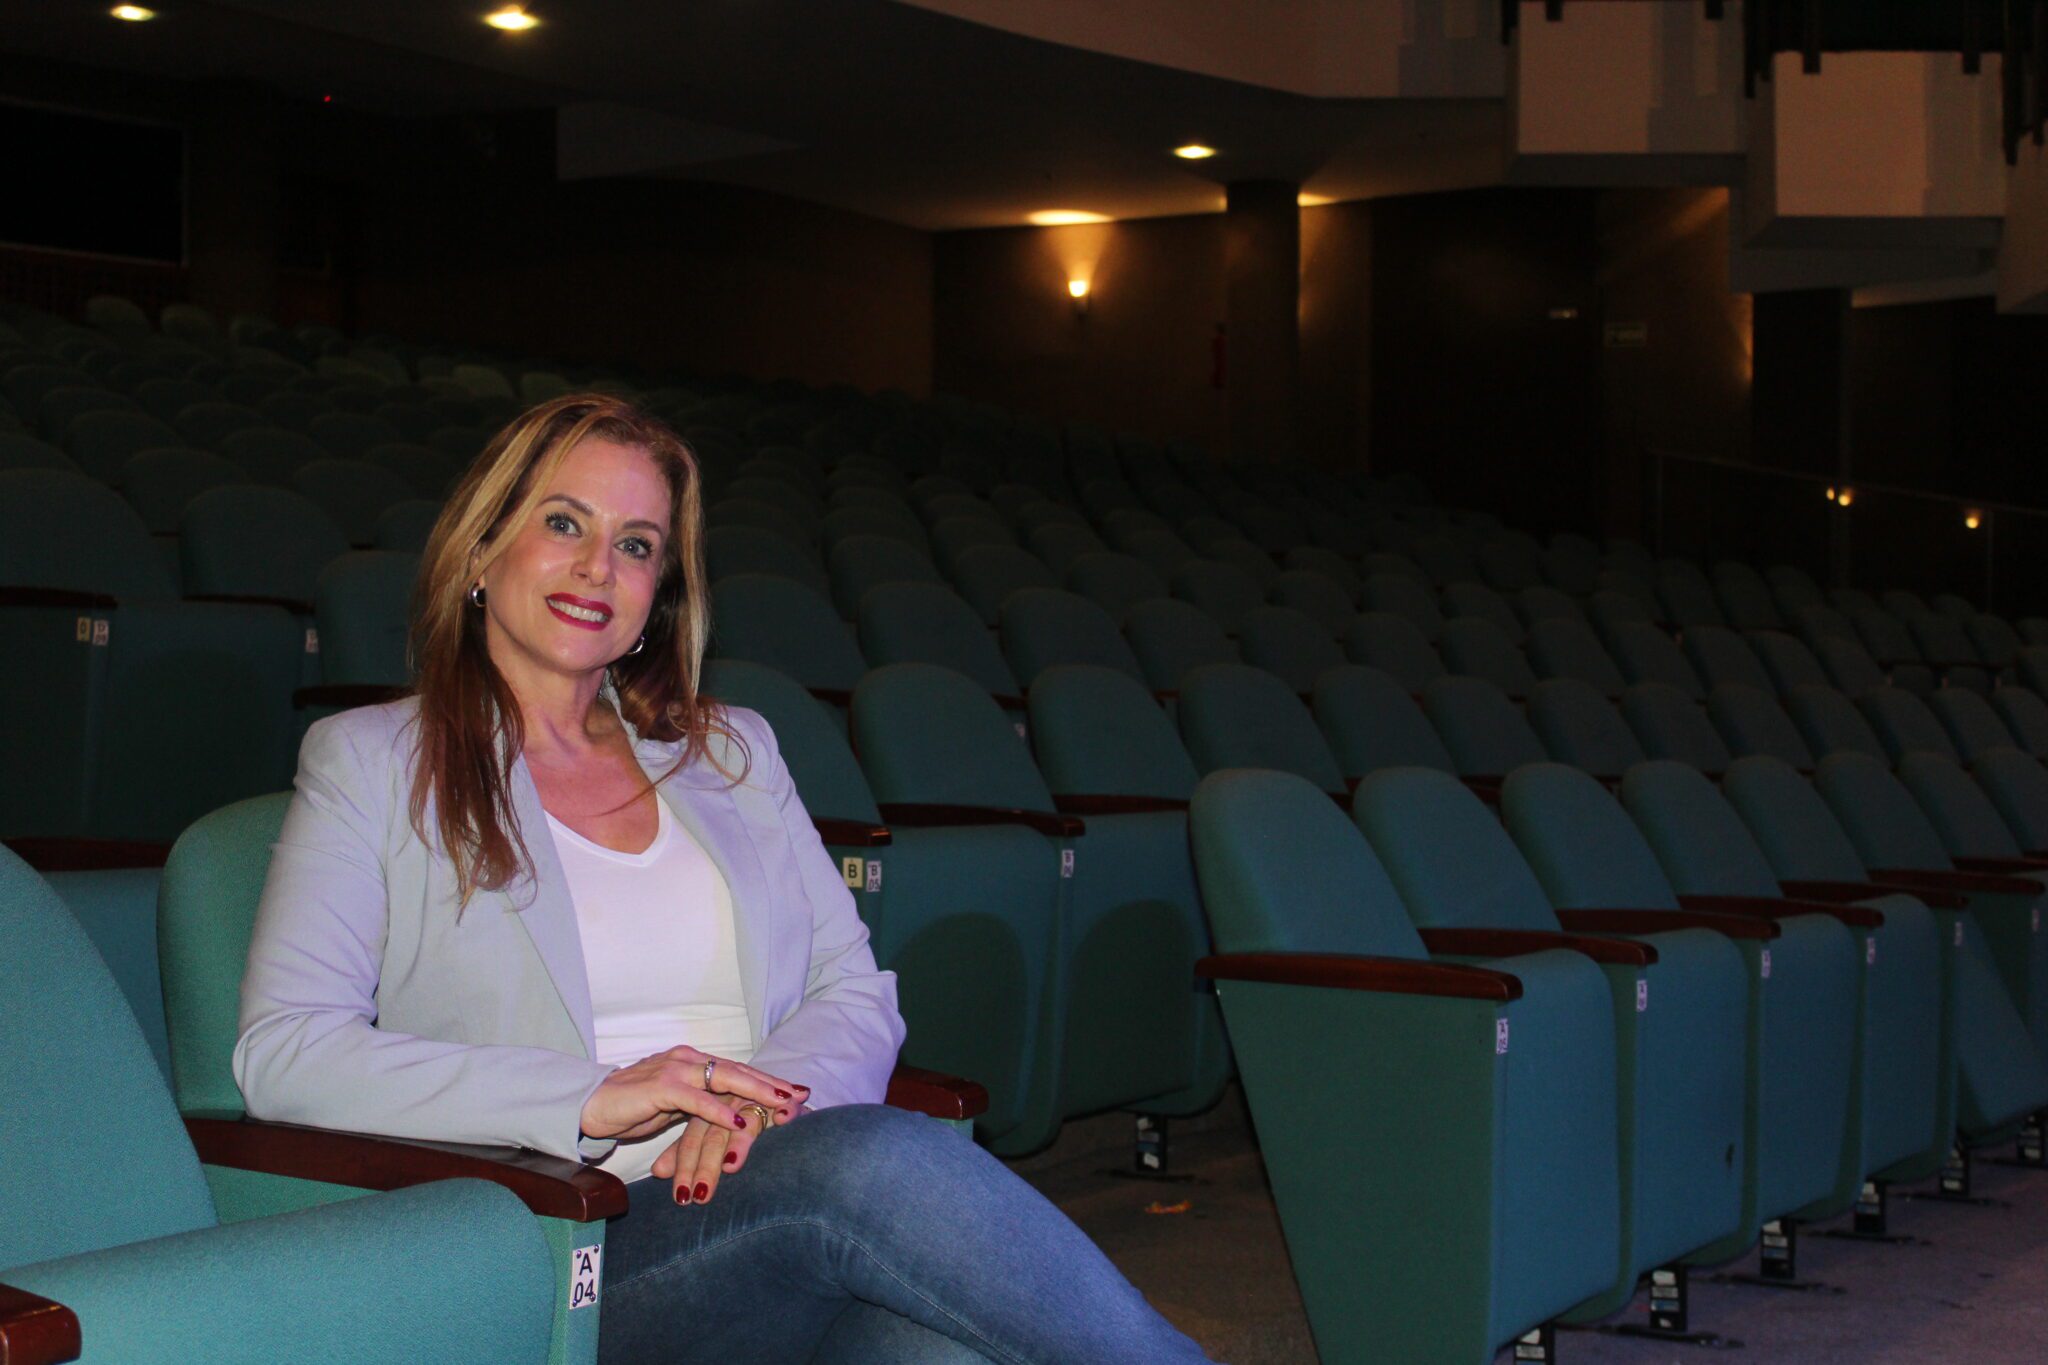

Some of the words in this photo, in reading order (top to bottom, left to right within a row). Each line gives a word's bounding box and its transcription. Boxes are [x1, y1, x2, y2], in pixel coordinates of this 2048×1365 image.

[848, 864, 857, 878] B
[871, 865, 878, 876] B
[869, 879, 880, 891] 05
[579, 1253, 593, 1275] A
[574, 1279, 595, 1303] 04
